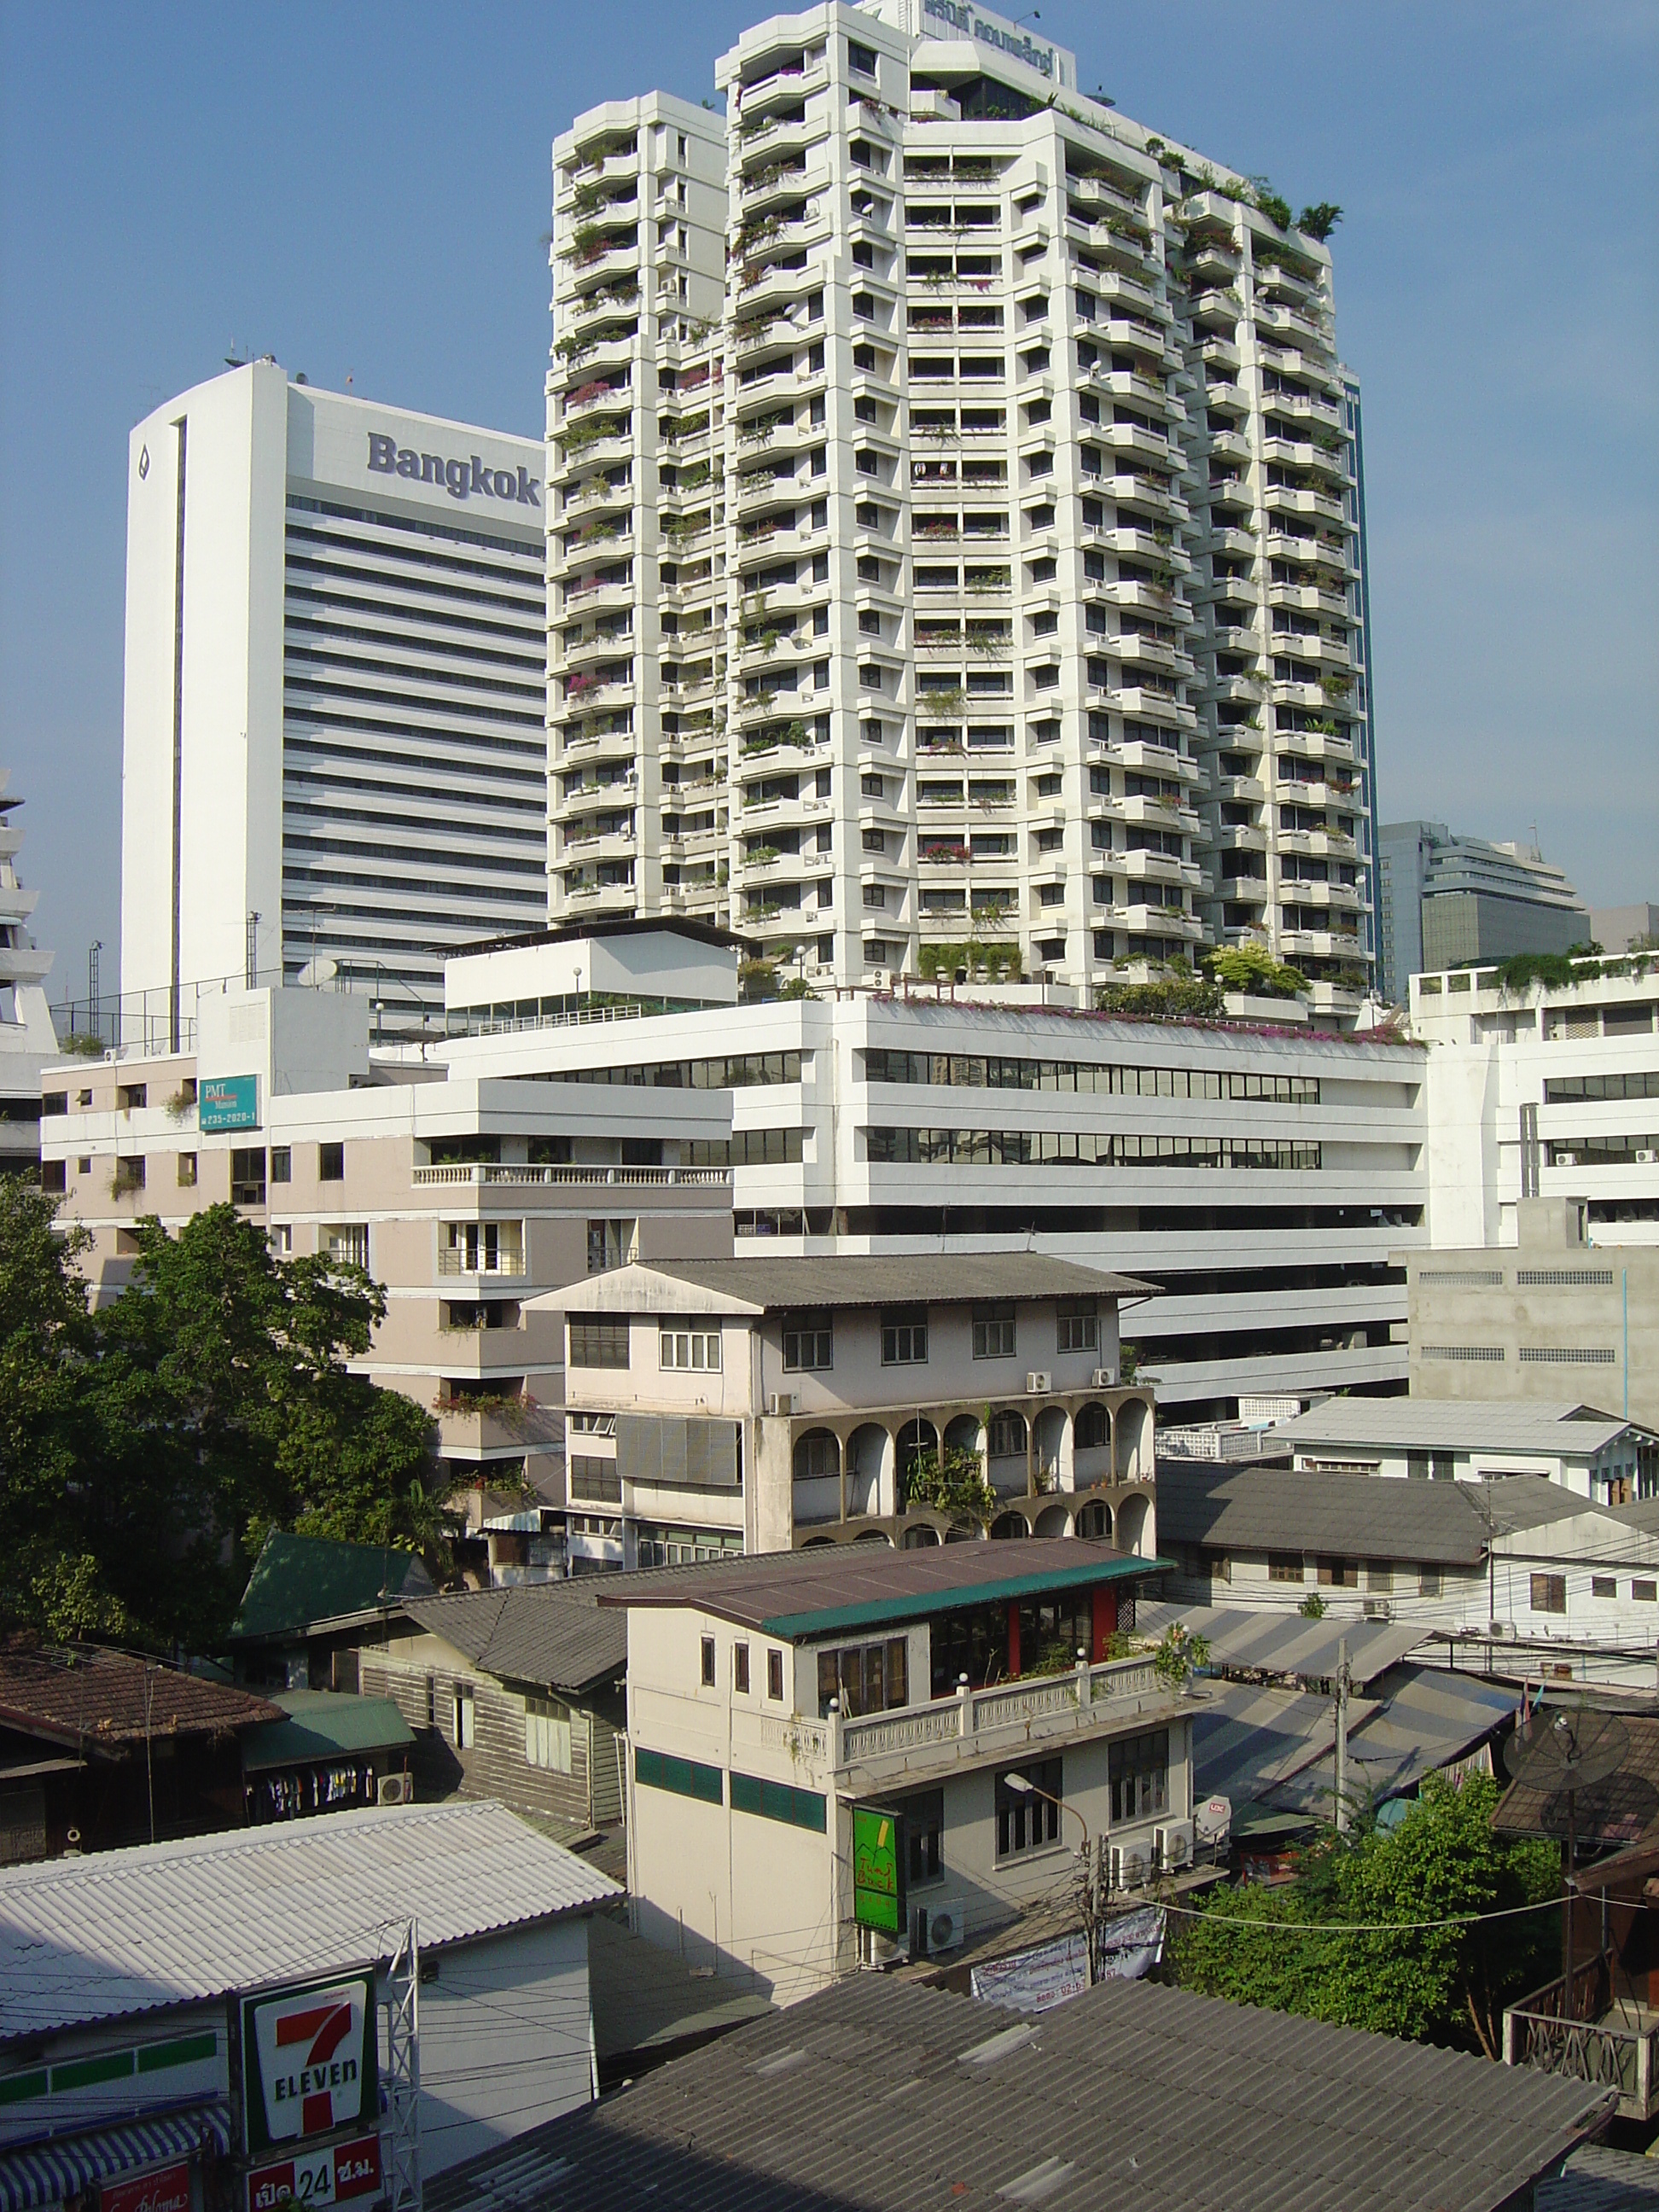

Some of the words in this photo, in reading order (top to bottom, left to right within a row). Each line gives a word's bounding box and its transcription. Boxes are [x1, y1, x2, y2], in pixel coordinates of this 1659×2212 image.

[367, 431, 541, 507] Bangkok
[205, 1083, 226, 1098] PMT
[255, 2182, 291, 2209] เปิด
[299, 2163, 331, 2199] 24
